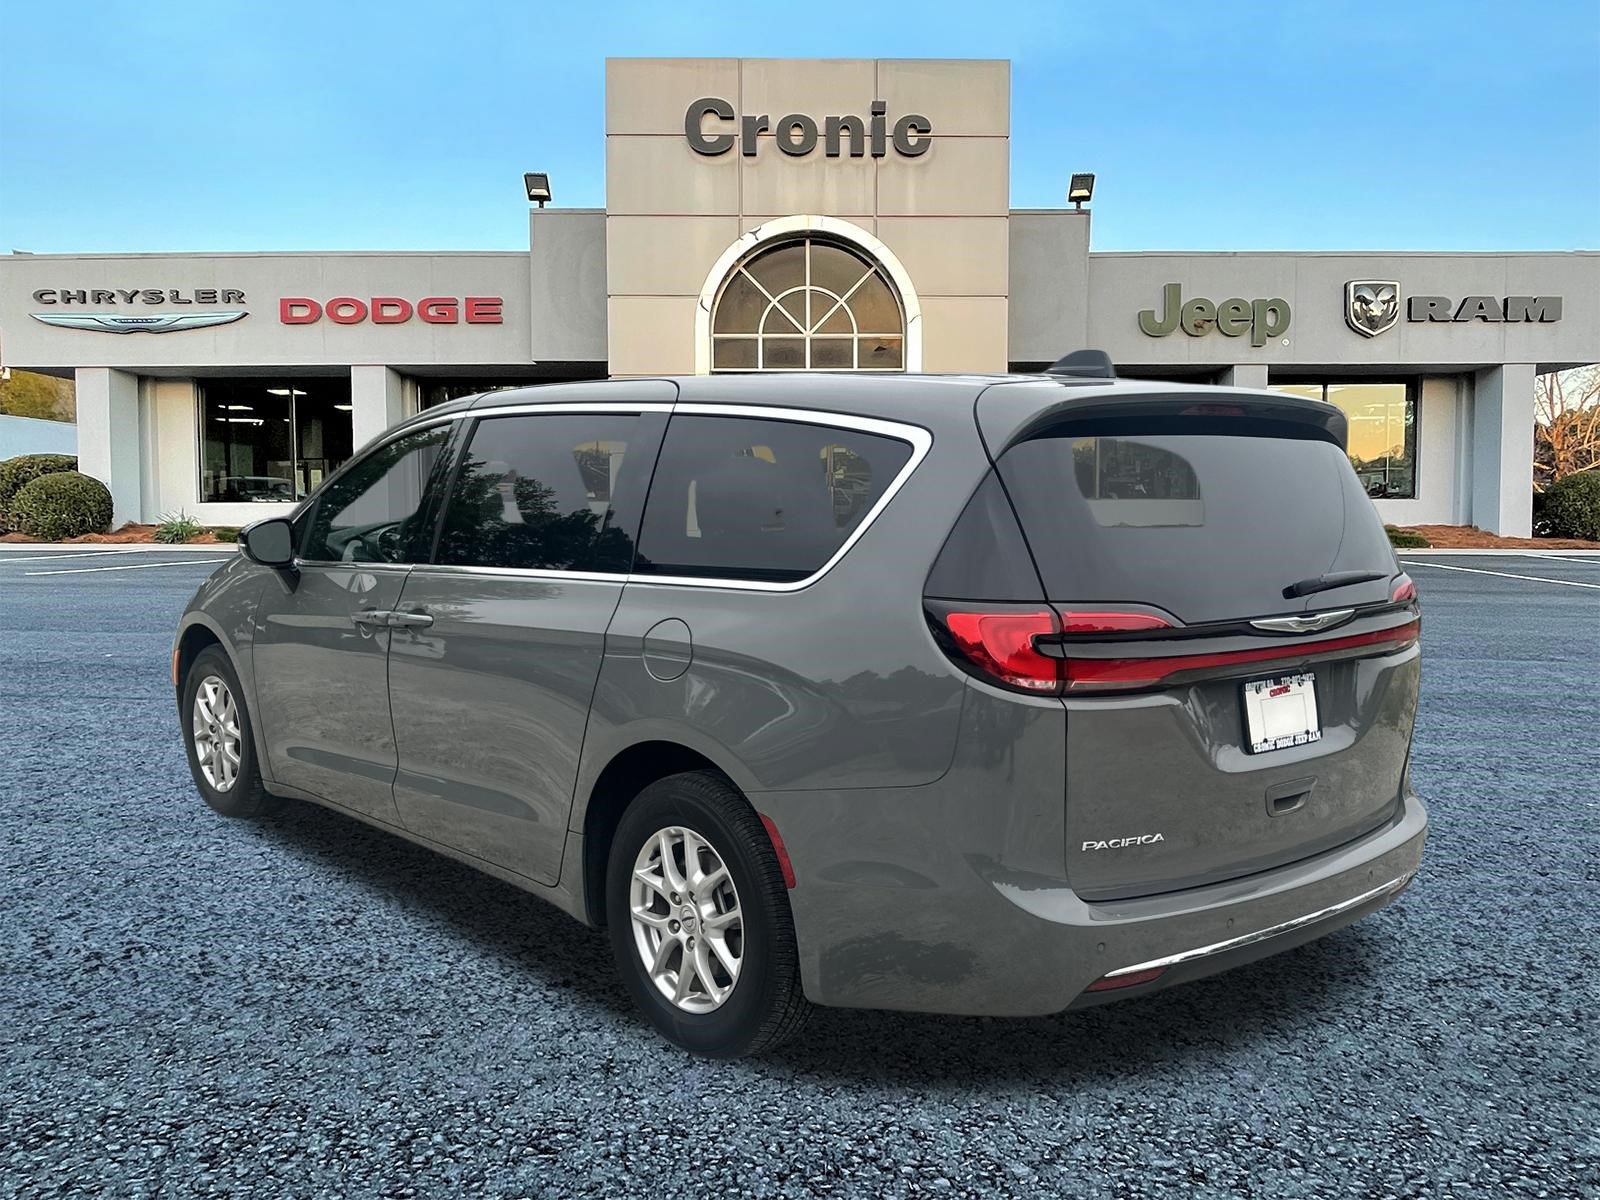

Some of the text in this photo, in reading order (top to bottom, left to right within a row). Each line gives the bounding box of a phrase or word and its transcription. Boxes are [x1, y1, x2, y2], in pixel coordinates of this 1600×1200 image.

[685, 97, 932, 157] Cronic
[32, 288, 246, 304] CHRYSLER
[1407, 296, 1563, 323] RAM
[280, 296, 504, 325] DODGE
[1138, 283, 1292, 347] Jeep
[1081, 833, 1164, 851] PACIFICA
